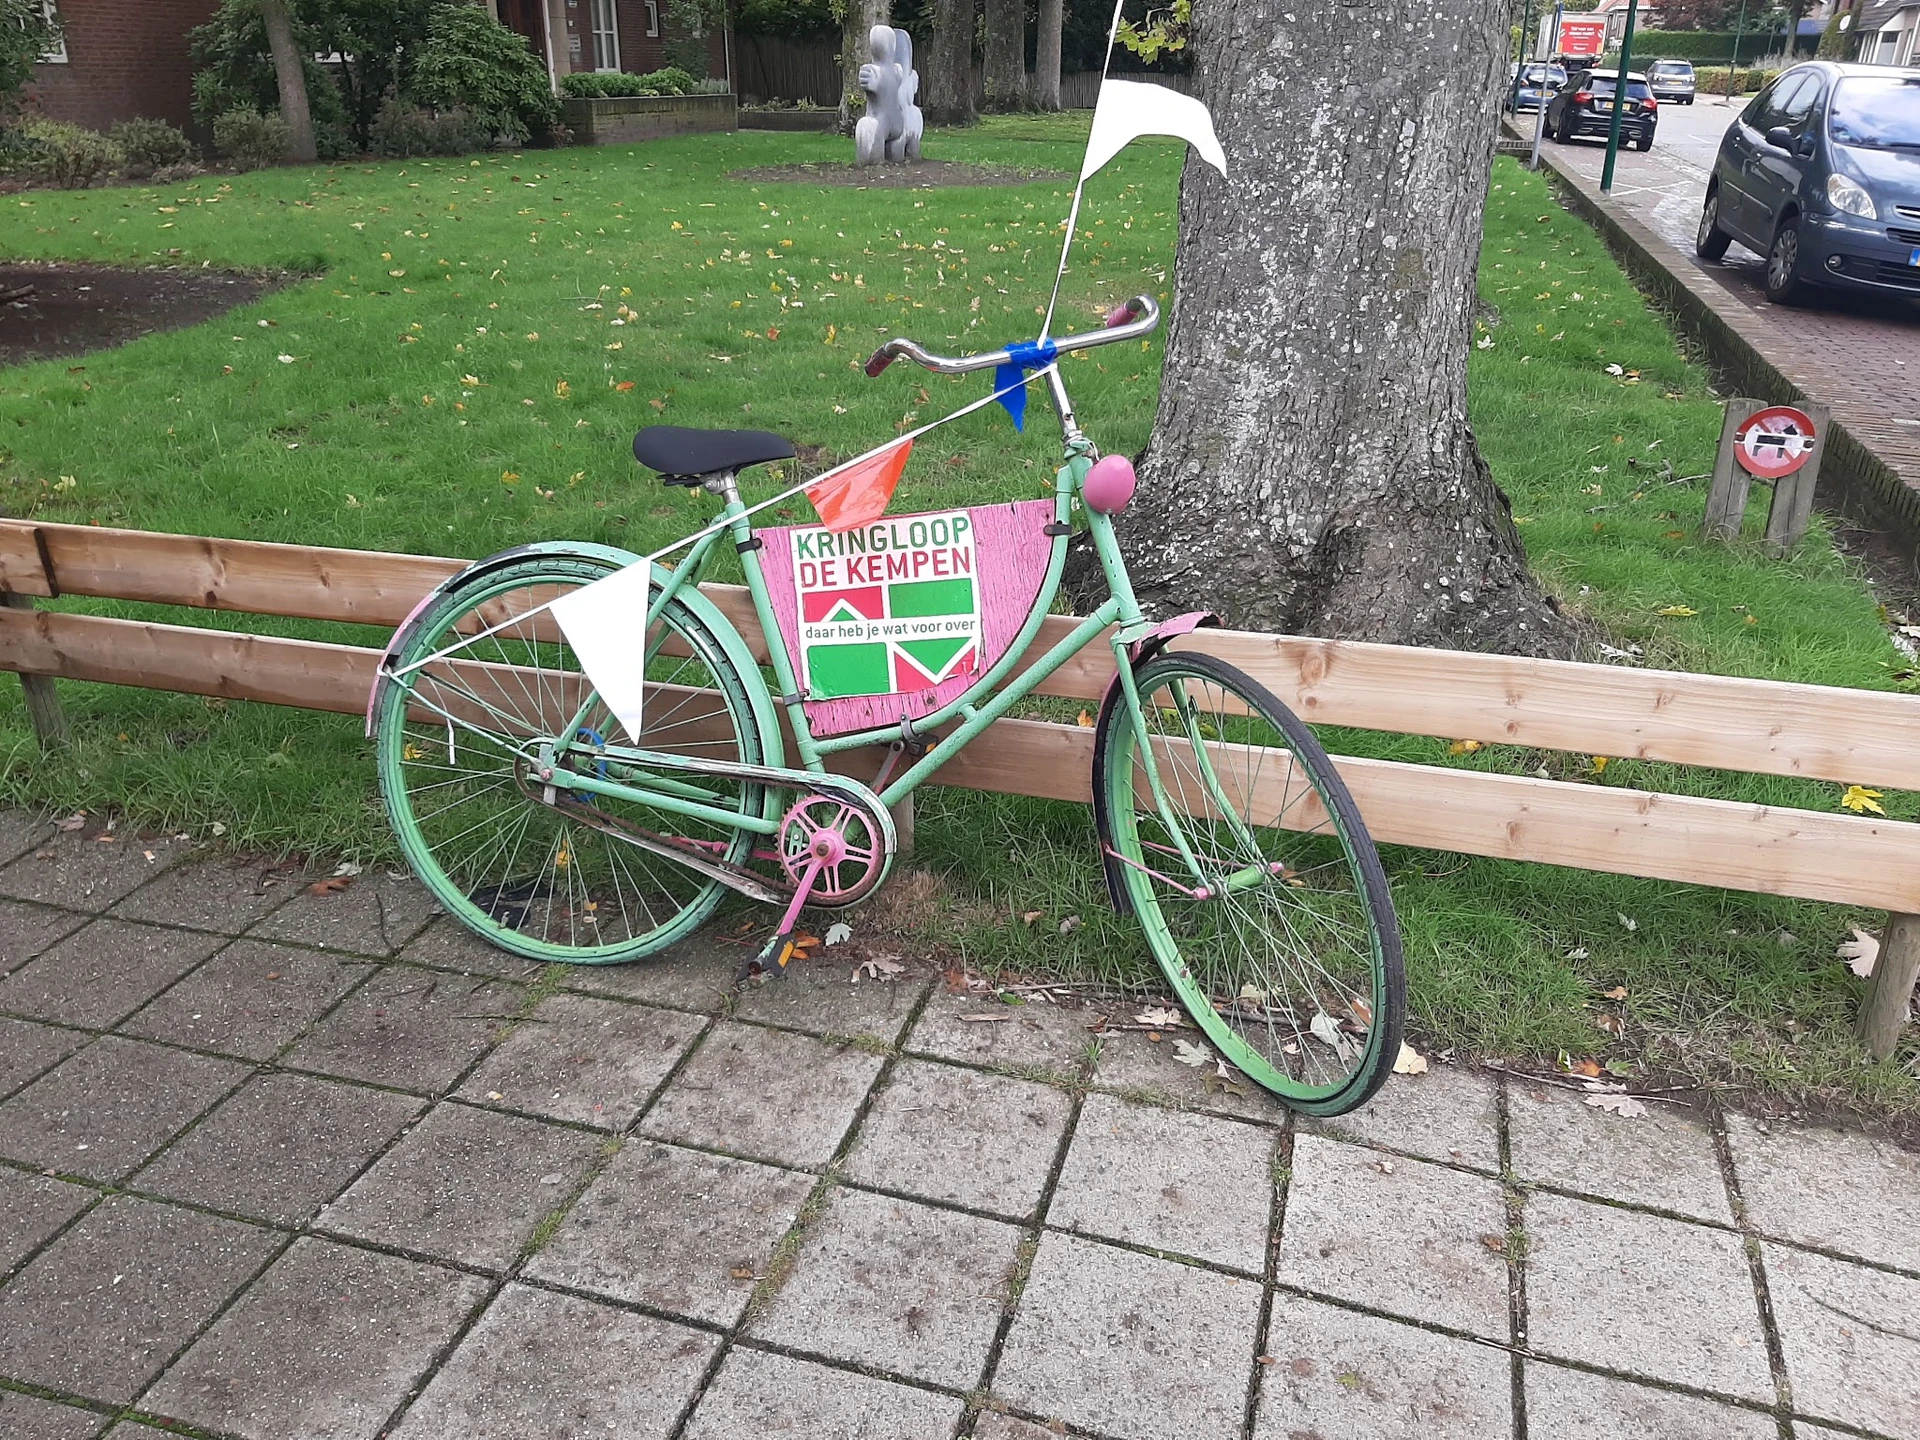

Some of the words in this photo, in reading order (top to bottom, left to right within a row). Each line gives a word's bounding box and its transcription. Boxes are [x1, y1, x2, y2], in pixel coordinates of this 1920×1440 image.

[797, 517, 968, 559] KRINGLOOP
[800, 560, 837, 588] DE
[847, 546, 970, 584] KEMPEN
[806, 625, 835, 638] daar
[839, 625, 863, 637] heb
[867, 623, 879, 640] je
[883, 623, 908, 635] wat
[912, 621, 942, 634] voor
[945, 620, 975, 630] over
